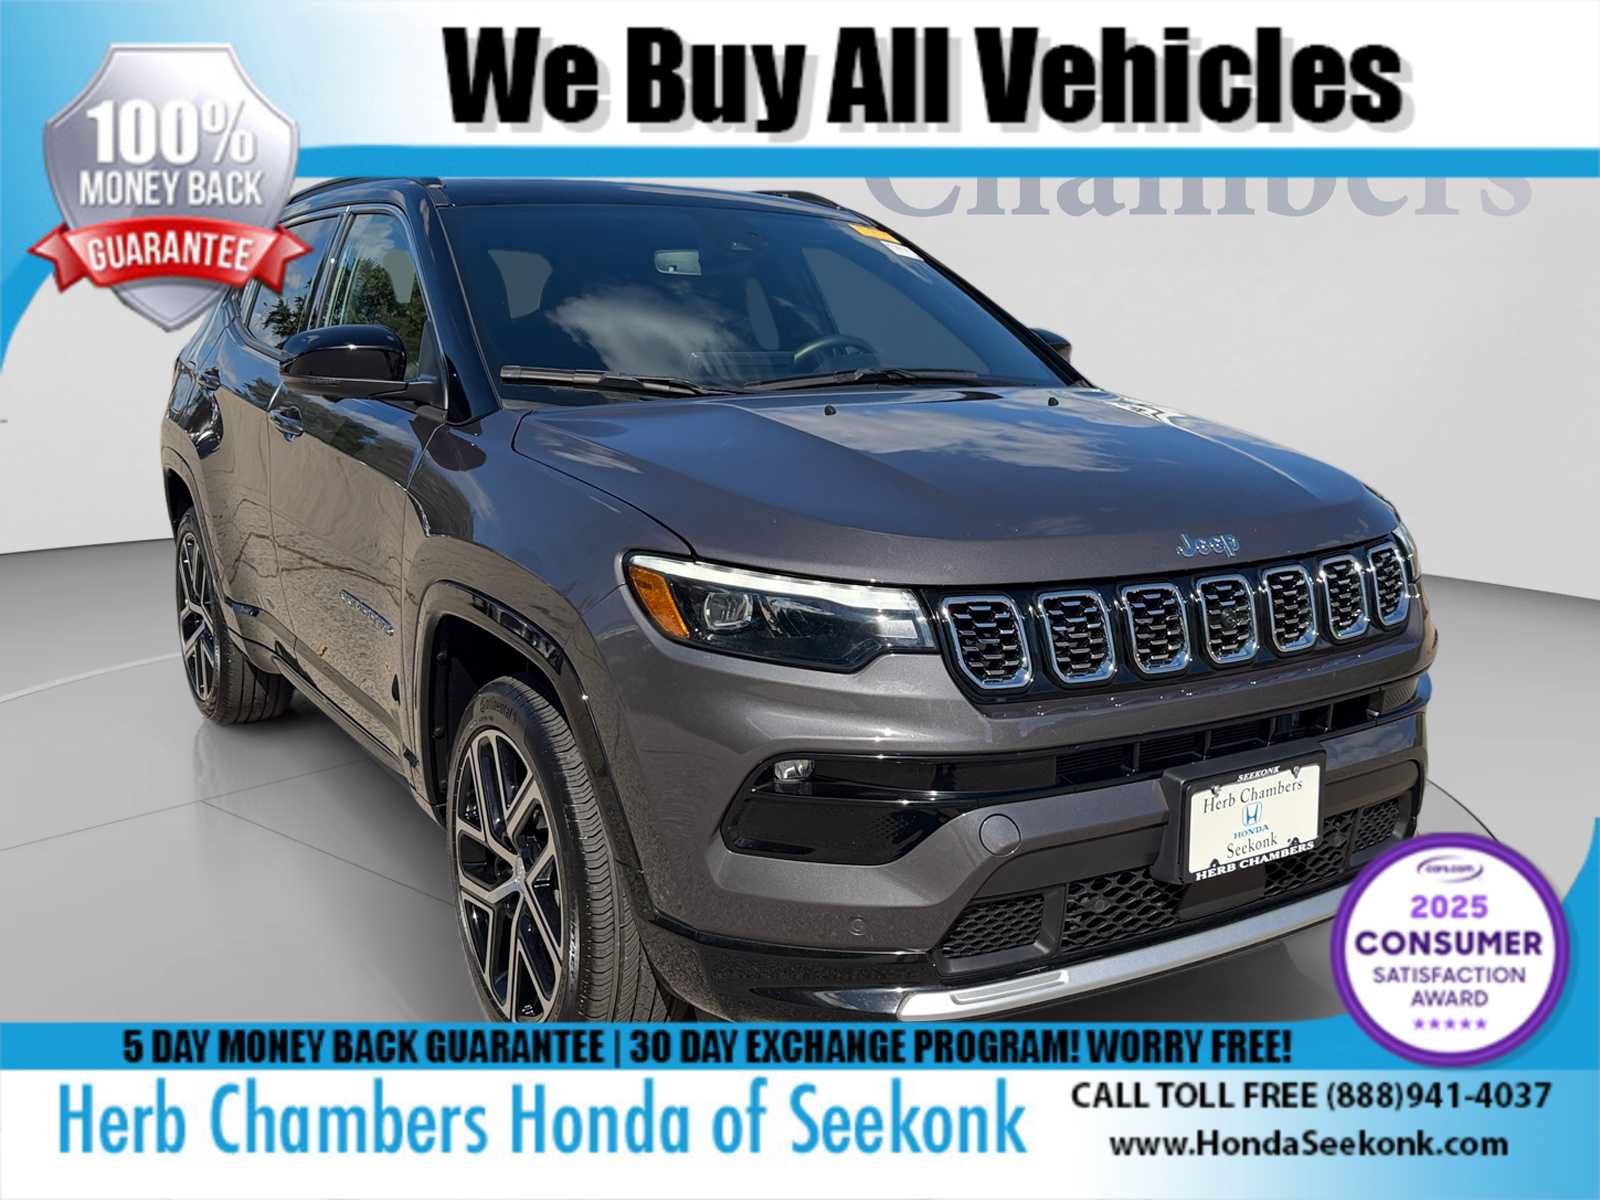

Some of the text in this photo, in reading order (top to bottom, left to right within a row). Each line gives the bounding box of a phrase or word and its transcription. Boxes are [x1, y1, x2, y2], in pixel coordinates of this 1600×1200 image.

[1177, 533, 1240, 558] Jeep
[1237, 766, 1281, 783] SEEKONK
[1203, 780, 1303, 814] Herb Chambers
[1233, 824, 1270, 840] HONDA
[1226, 832, 1278, 859] Seekonk
[1195, 841, 1315, 881] HERB CHAMBERS
